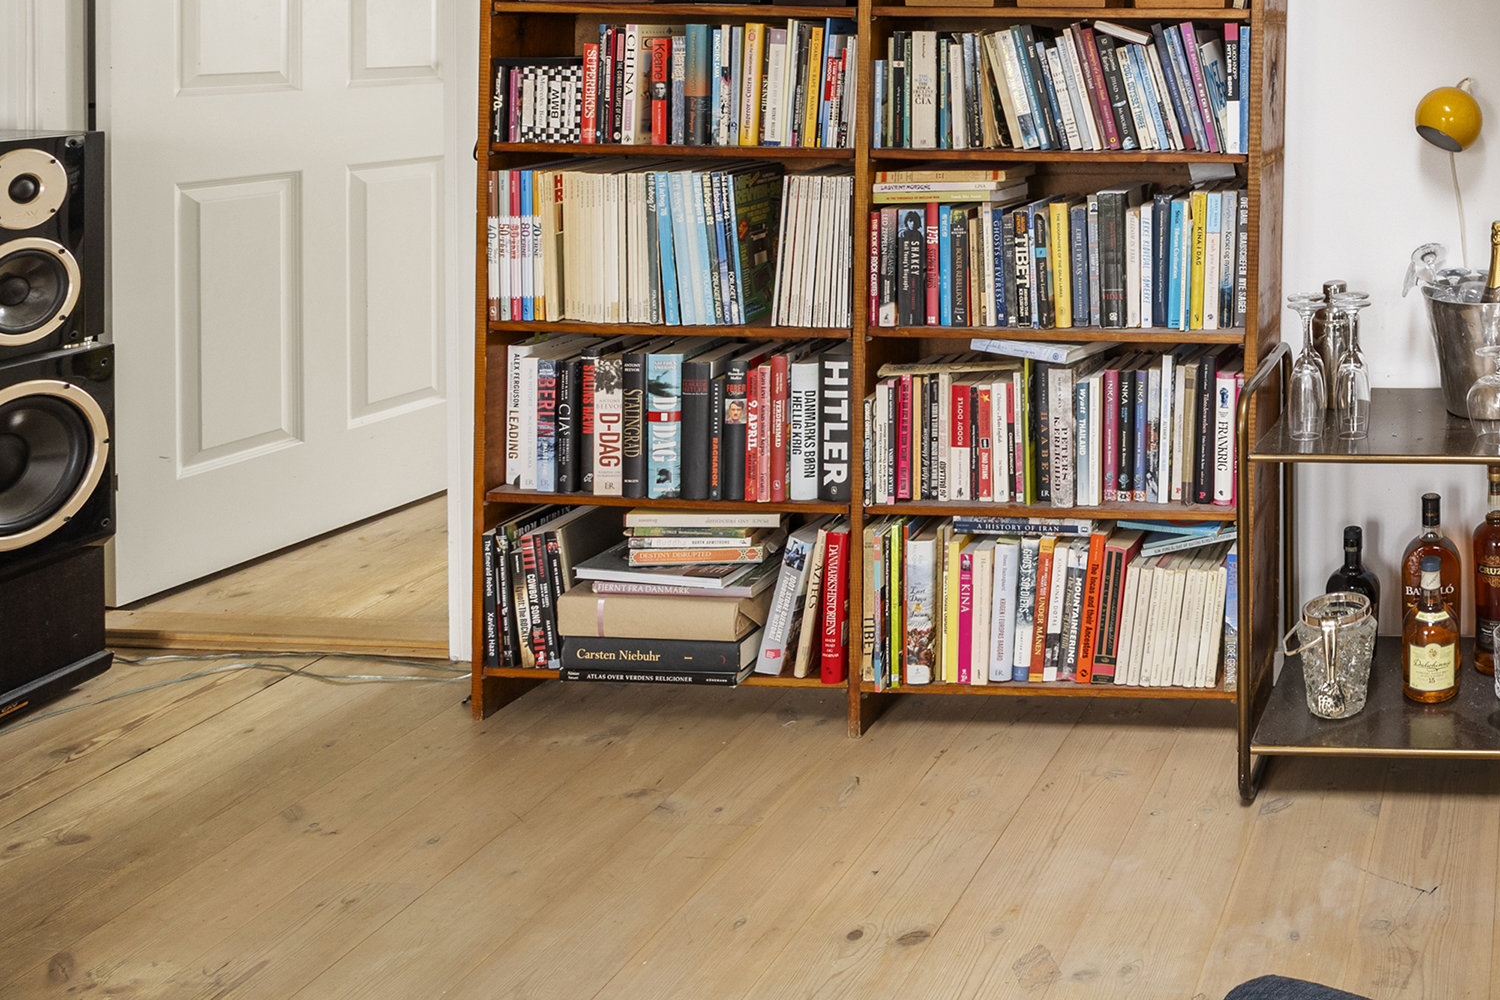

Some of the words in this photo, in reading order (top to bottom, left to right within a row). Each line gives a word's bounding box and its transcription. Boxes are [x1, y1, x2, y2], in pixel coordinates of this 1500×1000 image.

[624, 34, 636, 96] CHINA
[654, 44, 666, 80] Keane
[584, 50, 596, 118] SUPERBIKES
[551, 88, 560, 118] BMW
[1240, 197, 1248, 208] OVE
[1240, 210, 1248, 226] DAHL
[993, 220, 1001, 255] GHOSTS
[1074, 228, 1082, 246] TIBET
[911, 240, 919, 276] SHAKEY
[1015, 234, 1030, 288] TIBET
[994, 267, 1002, 302] EVEREST
[1238, 288, 1246, 313] SAGER
[582, 365, 594, 404] STALINS
[1106, 380, 1114, 402] INKA
[538, 378, 555, 438] BERLIN
[582, 406, 594, 434] HÆVN
[748, 400, 758, 410] 9.
[792, 396, 802, 430] HELLIG
[804, 390, 816, 448] DANMARKS
[508, 410, 519, 460] LEADING
[600, 412, 620, 468] D-DAG
[622, 388, 643, 458] STALINGRAD
[748, 413, 758, 451] APRIL
[823, 361, 848, 486] HITLER
[792, 432, 802, 456] KRIG
[1040, 412, 1049, 484] HAABET
[1217, 421, 1228, 472] FRANKRIG
[804, 451, 816, 478] BØRN
[1021, 548, 1033, 573] GHOST
[526, 574, 538, 604] COWBOY
[596, 583, 628, 592] FJERNT
[628, 584, 646, 592] FRA
[647, 584, 690, 593] DANMARK
[809, 563, 823, 610] AZTECS
[826, 544, 838, 635] DANMARKSHISTORIENS
[960, 584, 970, 612] KINA
[1020, 576, 1032, 613] SOLDIERS
[1088, 596, 1096, 608] and
[1405, 583, 1454, 596] BALÓ
[531, 606, 540, 624] SONG
[1038, 596, 1048, 624] UNDER
[1066, 577, 1082, 664] MOUNTAINEERING
[1086, 609, 1094, 625] their
[864, 614, 874, 656] TIBET
[1034, 626, 1046, 655] MÅNEN
[1082, 626, 1094, 658] Ancestors
[576, 648, 616, 660] Carsten
[618, 650, 661, 662] Niebuhr
